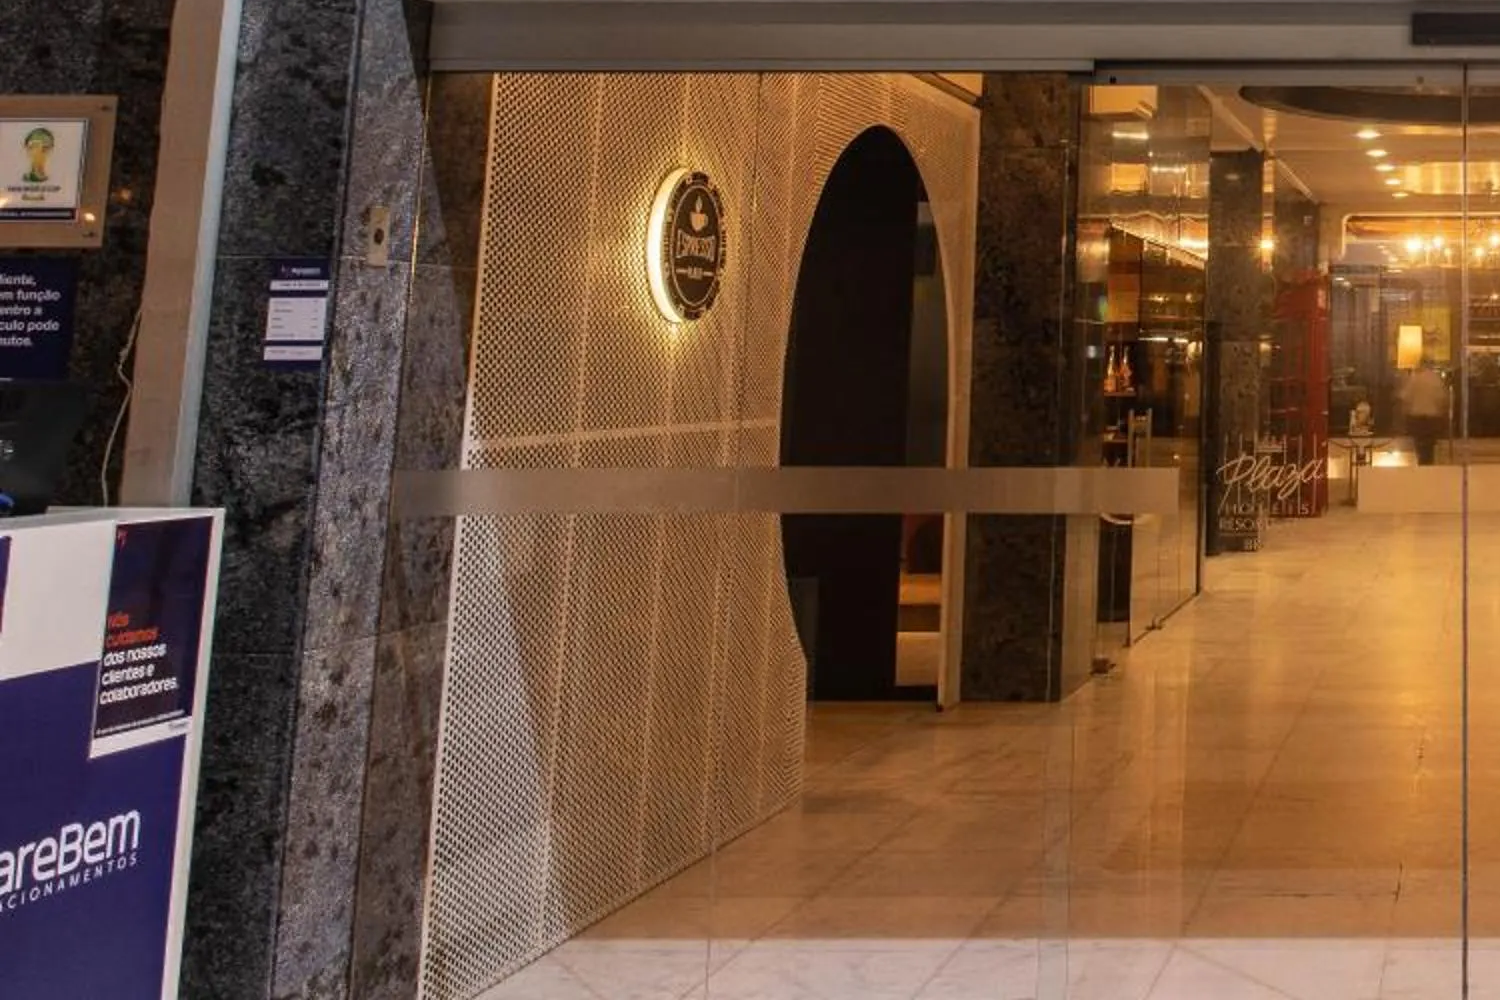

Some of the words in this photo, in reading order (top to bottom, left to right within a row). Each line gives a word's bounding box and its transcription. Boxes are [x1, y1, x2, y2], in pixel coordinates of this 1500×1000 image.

[16, 288, 61, 302] função
[26, 318, 61, 333] pode
[1215, 452, 1325, 512] Plaza
[103, 651, 125, 667] dos
[127, 642, 168, 662] nossos
[101, 664, 145, 686] clientes
[146, 663, 156, 678] e
